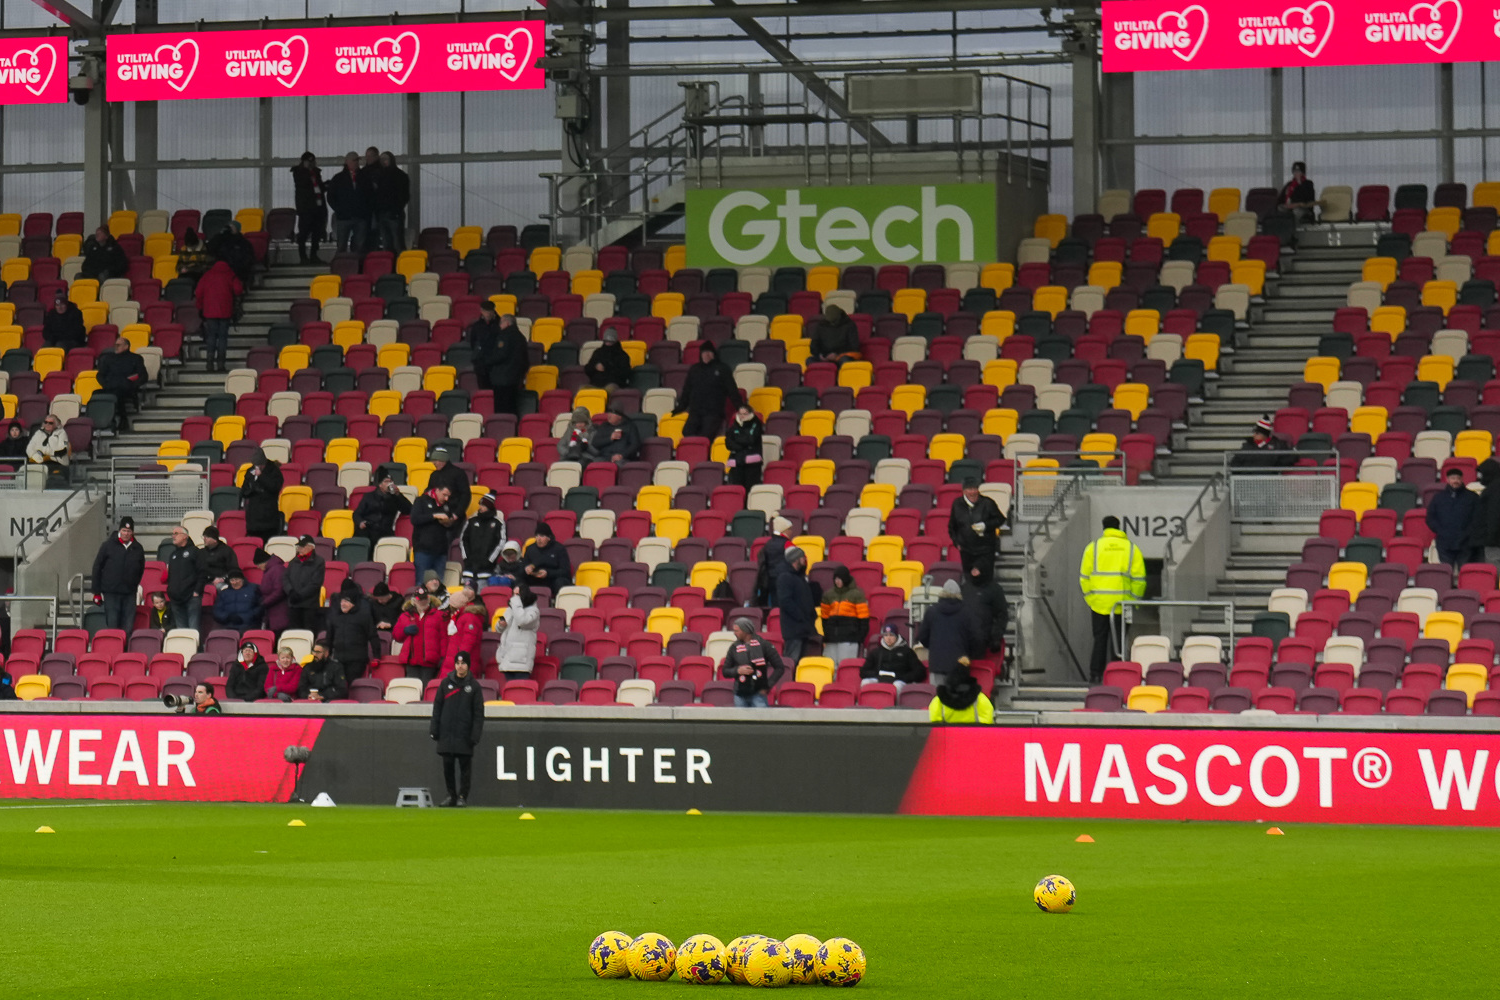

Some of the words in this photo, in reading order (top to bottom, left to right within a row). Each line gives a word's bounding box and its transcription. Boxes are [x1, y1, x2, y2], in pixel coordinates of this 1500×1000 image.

[1115, 21, 1155, 31] UTILITA
[1239, 17, 1280, 27] UTILITA
[1366, 13, 1407, 23] UTILITA
[1115, 31, 1190, 50] GIVING
[1239, 27, 1316, 46] GIVING
[1366, 23, 1443, 42] GIVING
[226, 50, 262, 60] UTILITA
[336, 46, 372, 56] UTILITA
[447, 43, 484, 52] UTILITA
[118, 54, 153, 63] UTILITA
[336, 56, 403, 74] GIVING
[448, 53, 516, 70] GIVING
[118, 63, 183, 80] GIVING
[226, 60, 292, 77] GIVING
[709, 187, 974, 265] Gtech
[1123, 516, 1186, 537] N123
[497, 746, 713, 784] LIGHTER
